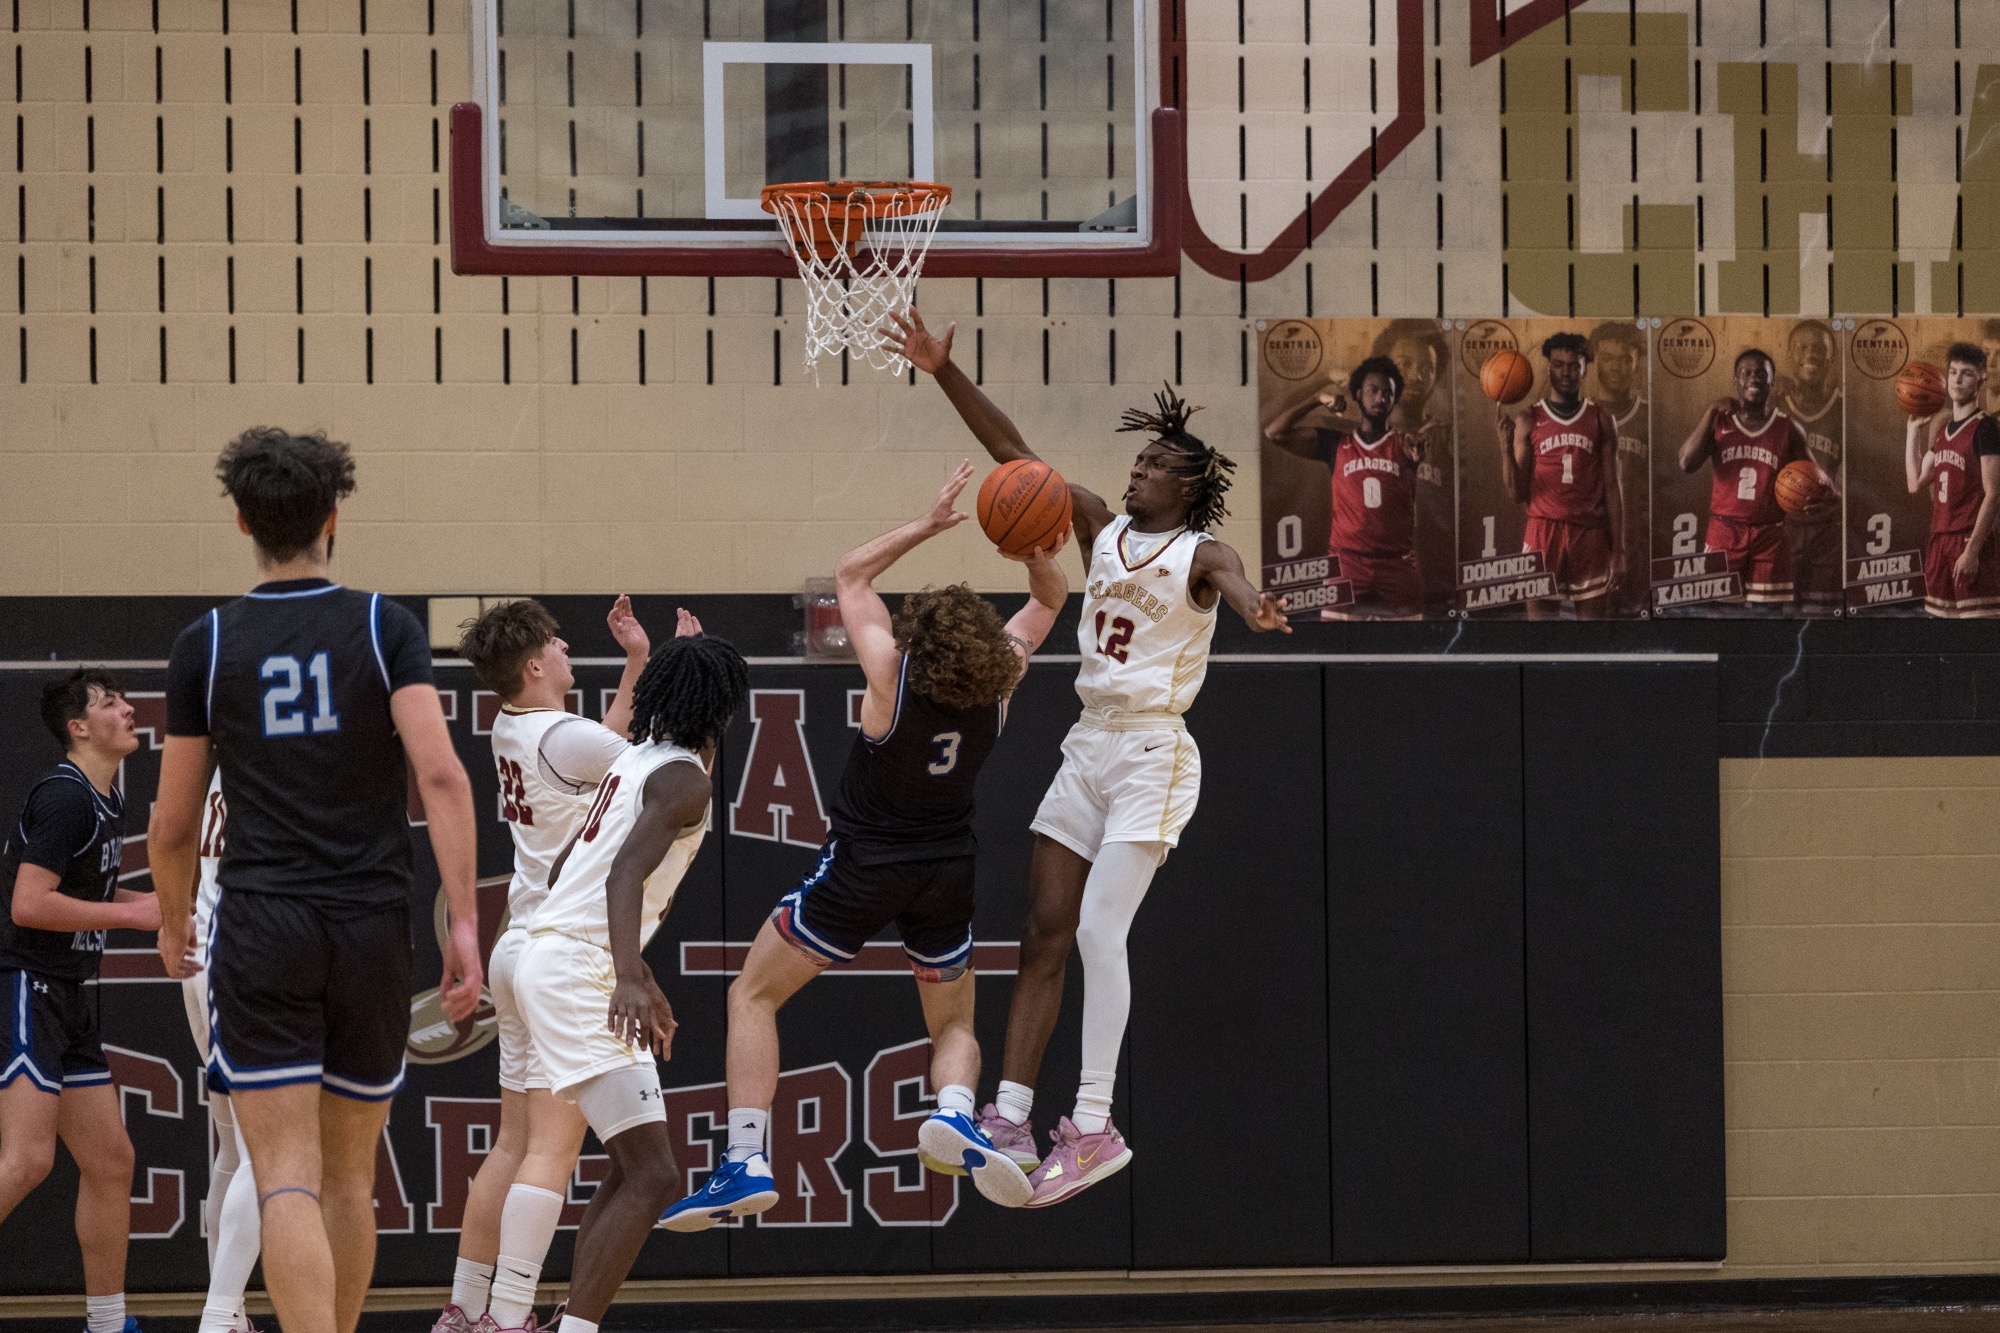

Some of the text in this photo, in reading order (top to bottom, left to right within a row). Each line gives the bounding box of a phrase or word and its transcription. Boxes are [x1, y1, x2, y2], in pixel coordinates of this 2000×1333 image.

[1269, 340, 1317, 350] CENTRAL
[1465, 340, 1513, 350] CENTRAL
[1663, 338, 1710, 348] CENTRAL
[1856, 340, 1903, 349] CENTRAL
[1539, 433, 1594, 455] CHARGERS
[1721, 445, 1779, 470] CHARGERS
[1343, 456, 1400, 477] CHARGERS
[1561, 453, 1573, 484] 1
[1362, 477, 1382, 508] 0
[1737, 466, 1758, 500] 2
[1938, 471, 1949, 504] 3
[1277, 515, 1302, 559] 0
[1481, 516, 1497, 558] 1
[1672, 512, 1698, 556] 2
[1866, 513, 1891, 556] 3
[1270, 559, 1329, 586] JAMES
[1462, 555, 1536, 584] DOMINIC
[1673, 556, 1706, 578] IAN
[1857, 555, 1911, 580] AIDEN
[1282, 585, 1338, 611] CROSS
[1465, 577, 1550, 608] LAMPTON
[1864, 580, 1913, 604] WALL
[1094, 610, 1135, 665] 12
[259, 650, 341, 738] 21
[928, 731, 961, 776] 3
[498, 754, 535, 827] 22
[578, 772, 622, 843] 10
